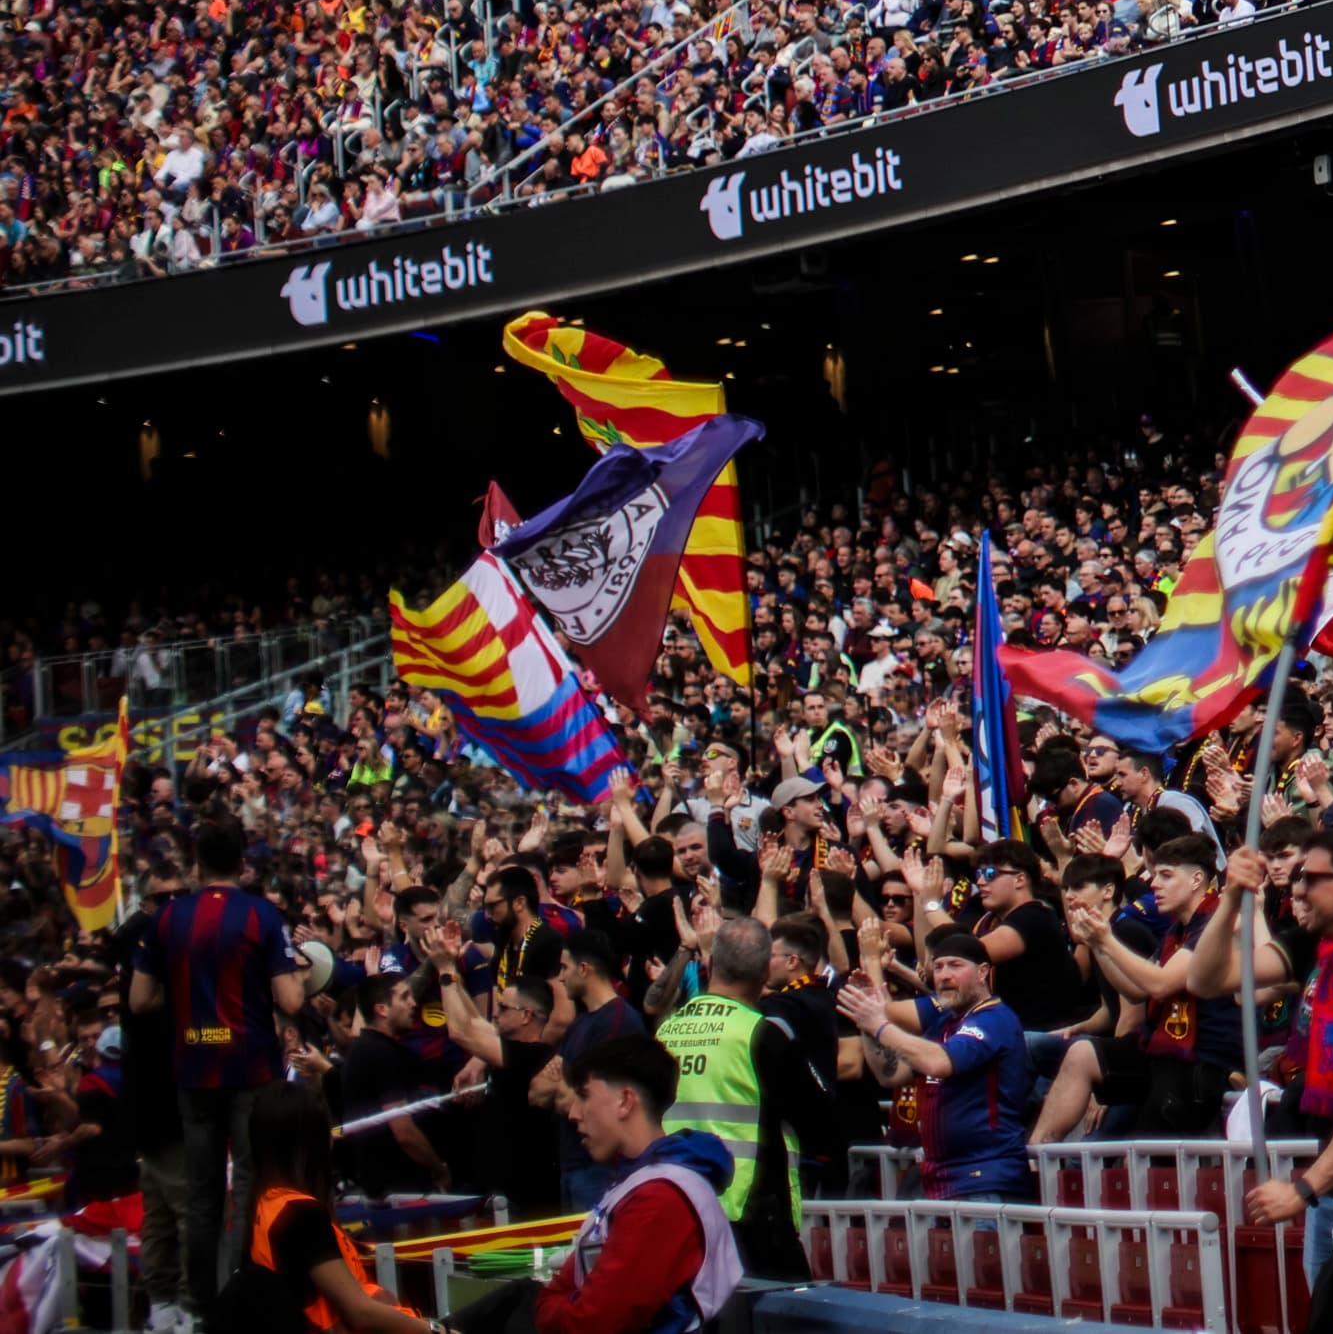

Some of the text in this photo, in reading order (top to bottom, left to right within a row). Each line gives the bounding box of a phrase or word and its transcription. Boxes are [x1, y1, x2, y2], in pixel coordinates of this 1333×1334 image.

[1168, 32, 1333, 118] whitebit
[749, 147, 903, 223] whitebit
[336, 242, 494, 310] whitebit
